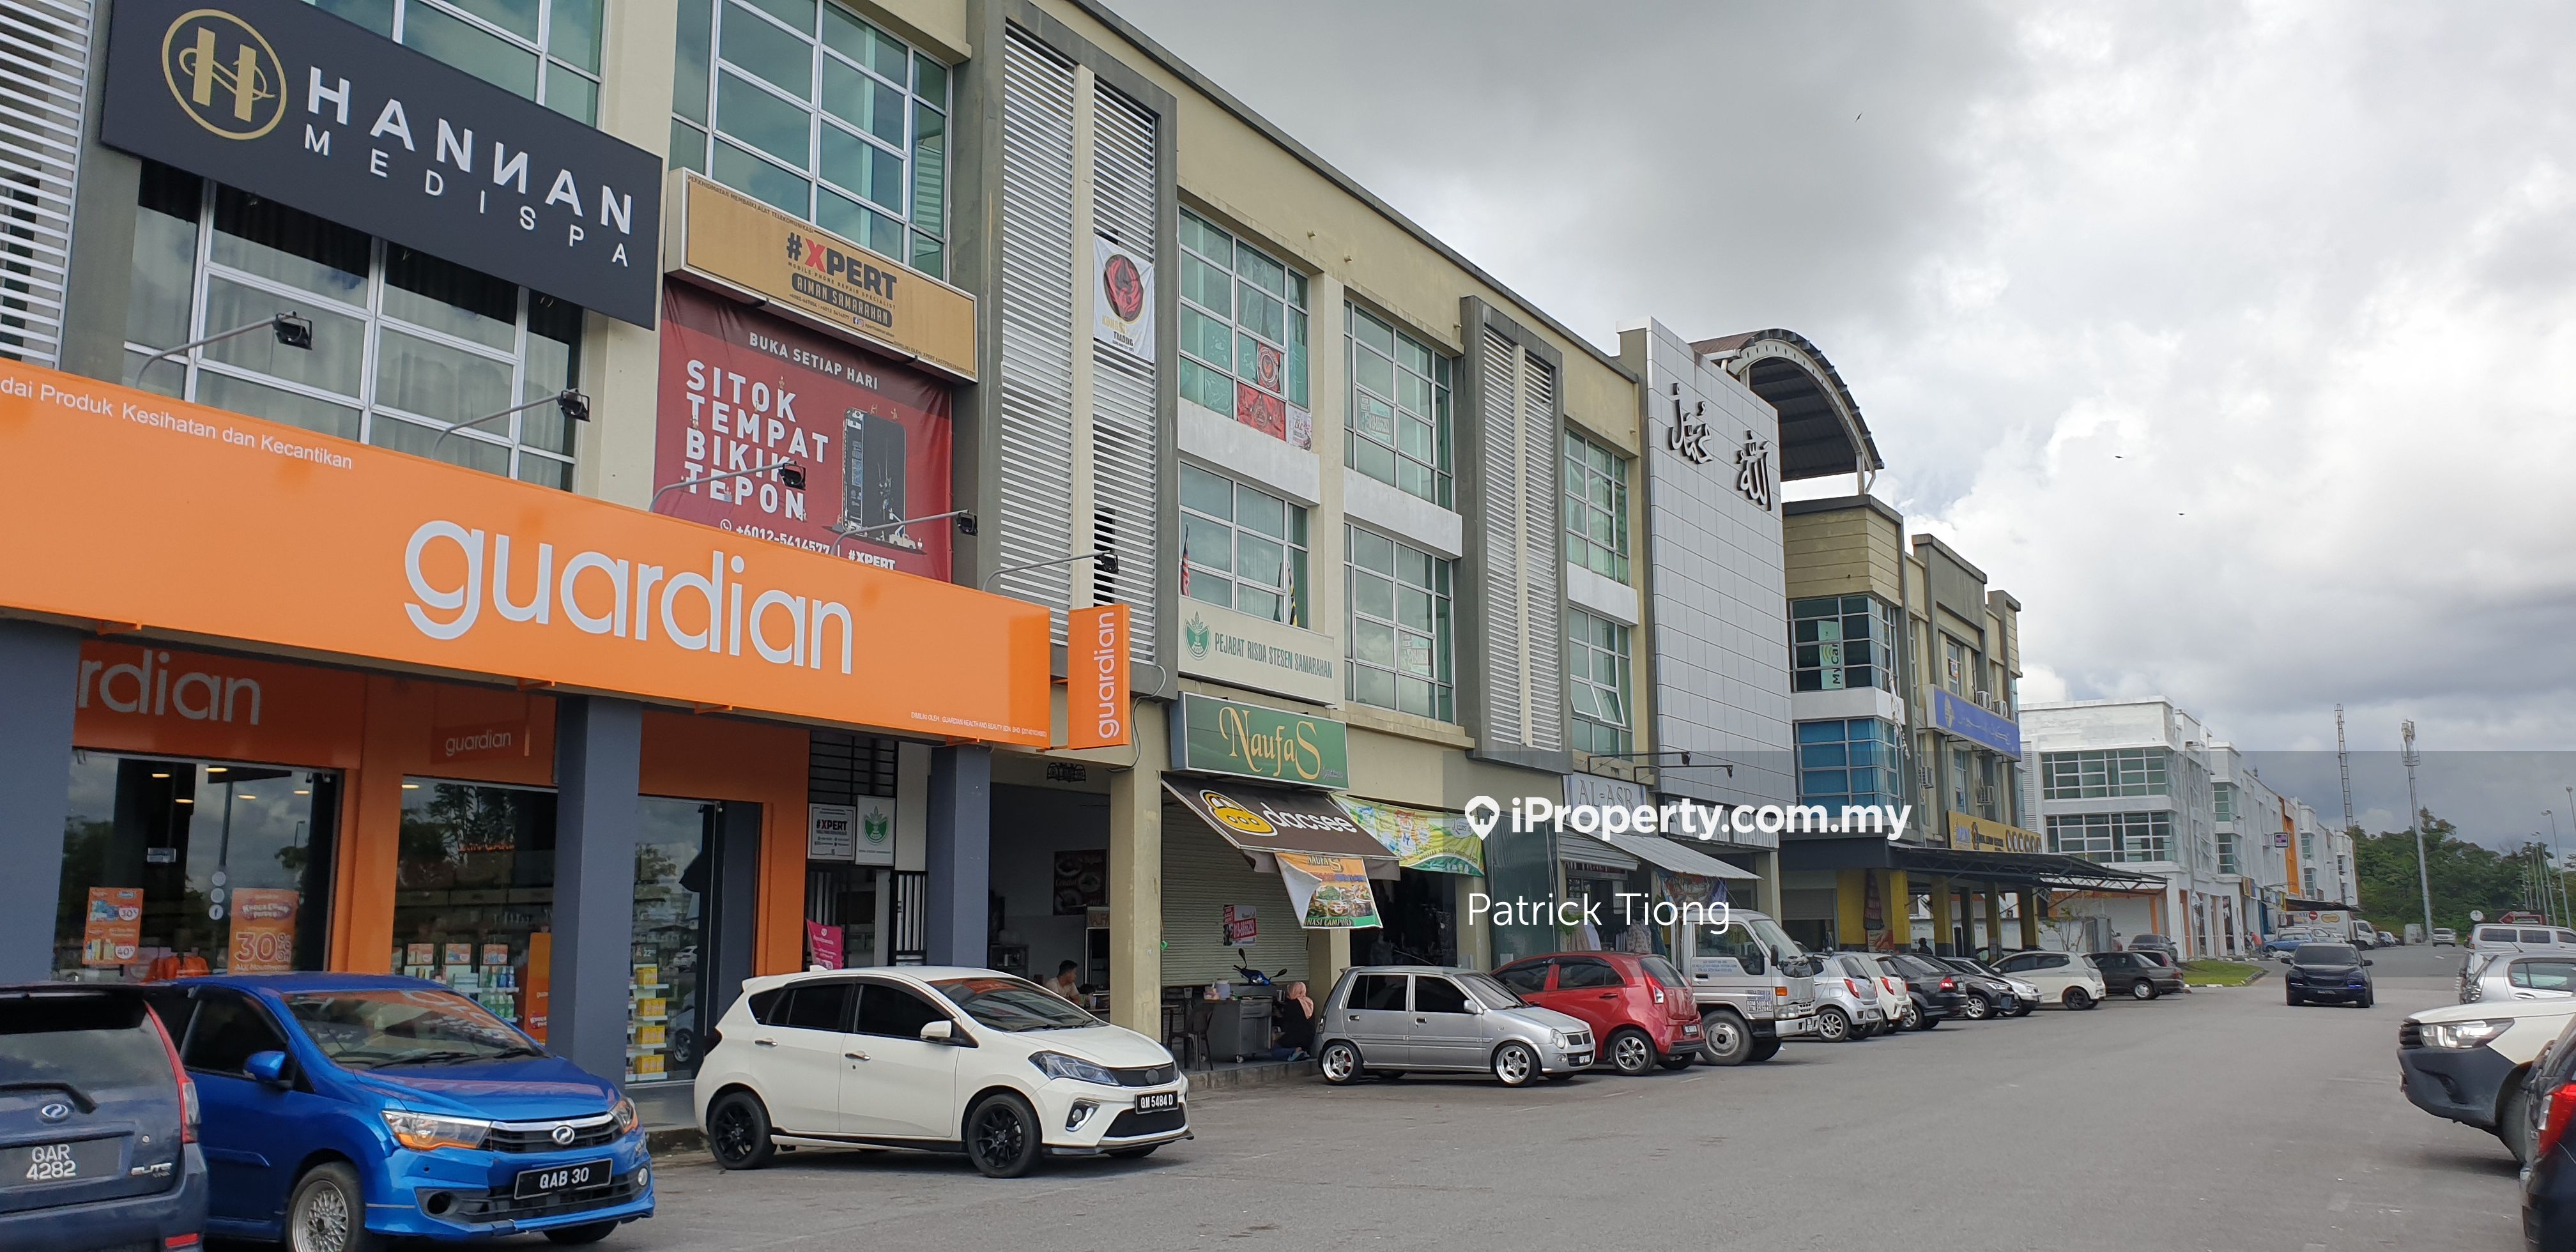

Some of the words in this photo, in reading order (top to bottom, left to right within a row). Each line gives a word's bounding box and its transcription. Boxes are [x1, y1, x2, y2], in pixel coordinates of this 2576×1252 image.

[305, 123, 628, 267] MEDISPA
[787, 232, 897, 300] #XPERT
[797, 277, 827, 300] AIMAN
[832, 291, 888, 324] SAMARAHAN
[749, 332, 788, 359] BUKA
[793, 348, 843, 376] SETIAP
[847, 367, 878, 390] HARI
[1114, 331, 1134, 347] TRADING
[686, 359, 797, 422] SITOK
[1, 376, 32, 400] dai
[40, 383, 113, 417] Produk
[123, 402, 216, 439] Kesihatan
[222, 427, 255, 448] dan
[261, 434, 352, 470] Kecantikan
[686, 392, 829, 463] TEMPAT
[684, 461, 805, 521] TEPON
[848, 549, 896, 570] #XPERT
[404, 520, 852, 675] guardian
[1093, 611, 1120, 739] guardian
[1215, 632, 1245, 657] PEJABAT
[1247, 641, 1267, 663] RISDA
[1269, 646, 1293, 669] STESEN
[1294, 653, 1333, 678] SAMARAHAN
[445, 729, 512, 757] guardian
[816, 819, 848, 831] #XPERT
[1260, 802, 1358, 833] dacsee
[1140, 1096, 1150, 1109] QM
[1151, 1094, 1168, 1107] 5484
[1169, 1094, 1174, 1106] D
[26, 1161, 77, 1181] 4282
[32, 1143, 70, 1164] QAR
[539, 1170, 568, 1189] QAB
[571, 1166, 590, 1184] 30
